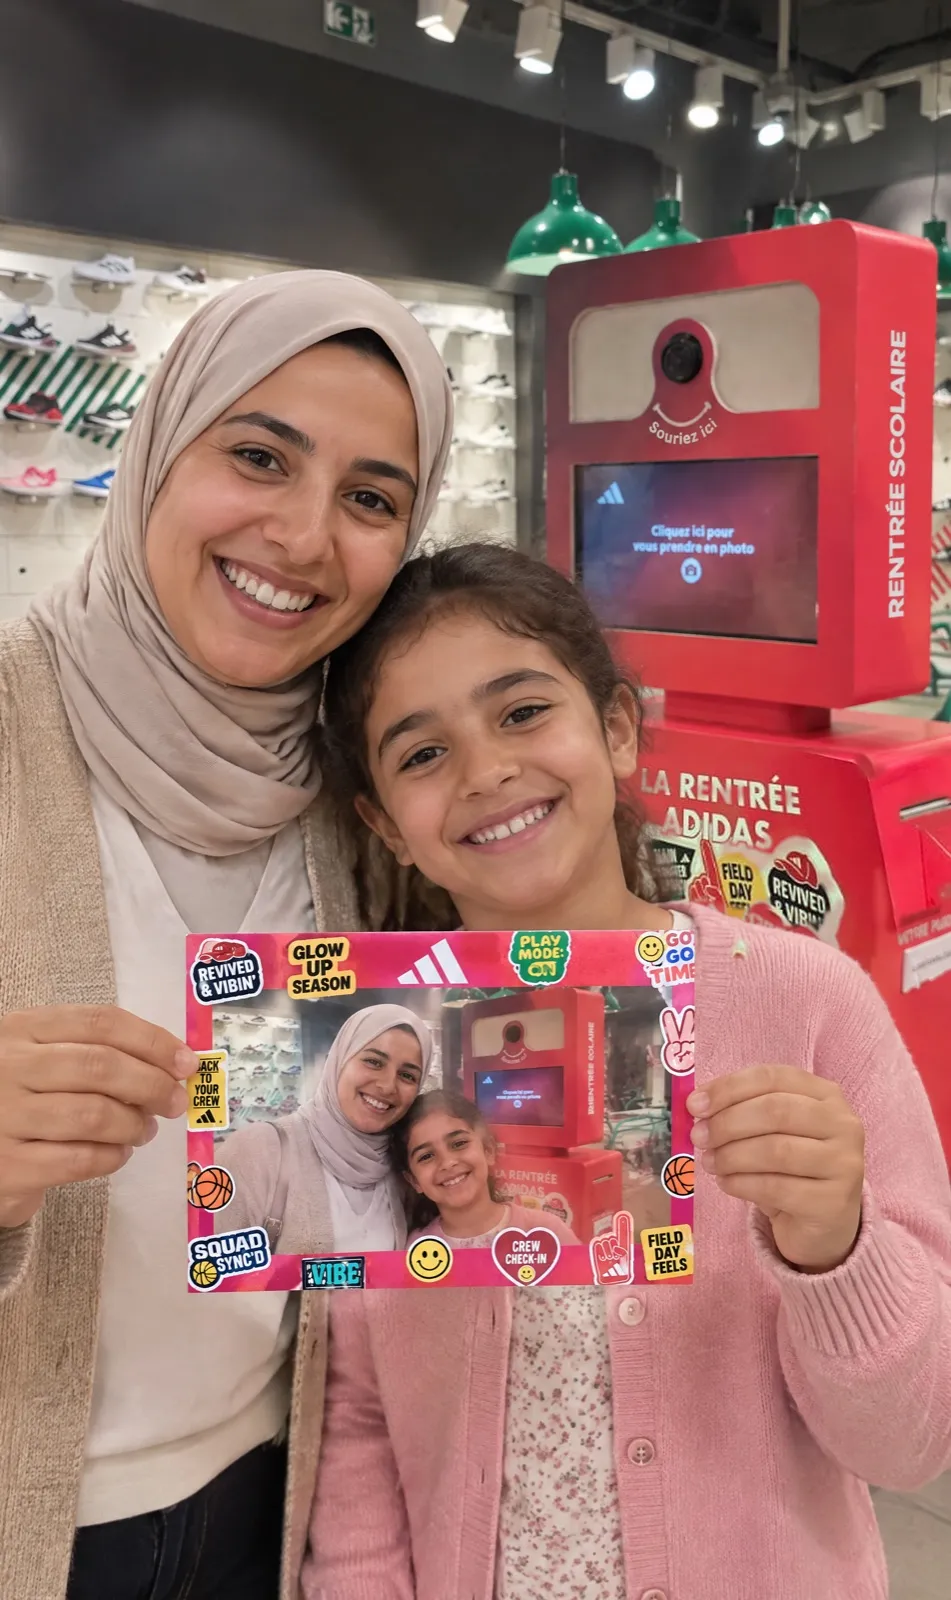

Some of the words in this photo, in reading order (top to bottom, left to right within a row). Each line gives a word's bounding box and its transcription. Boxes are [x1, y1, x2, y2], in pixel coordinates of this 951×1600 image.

[888, 330, 907, 477] SCOLAIRE
[649, 421, 699, 445] Souriez
[699, 417, 718, 438] ici
[651, 525, 691, 540] Cliquez
[692, 524, 705, 537] ici
[706, 528, 735, 540] pour
[632, 542, 658, 552] vous
[660, 540, 702, 555] prendre
[704, 543, 718, 554] en
[719, 541, 755, 557] photo
[885, 483, 905, 618] RENTRÉE
[640, 767, 671, 796] LA
[679, 772, 802, 815] RENTRÉE
[662, 806, 773, 850] ADIDAS
[721, 862, 754, 882] FIELD
[729, 882, 753, 901] DAY
[772, 876, 826, 914] REVIVED
[520, 935, 561, 948] PLAY
[293, 943, 344, 960] GLOW
[518, 947, 564, 960] MODE:
[666, 947, 694, 963] GO
[198, 959, 255, 982] REVIVED
[307, 959, 333, 976] UP
[527, 961, 557, 977] ON
[201, 983, 213, 997] &
[214, 975, 257, 995] VIBIN'
[292, 976, 351, 994] SEASON
[197, 1060, 219, 1072] ACK
[200, 1073, 212, 1083] TO
[195, 1084, 219, 1095] YOUR
[193, 1095, 220, 1107] CREW
[194, 1233, 263, 1260] SQUAD
[512, 1241, 540, 1252] CREW
[647, 1231, 684, 1247] FIELD
[216, 1250, 265, 1272] SYNC'D
[505, 1253, 547, 1265] CHECK-IN
[655, 1246, 680, 1261] DAY
[311, 1262, 359, 1285] VIBE
[652, 1258, 688, 1275] FEELS
